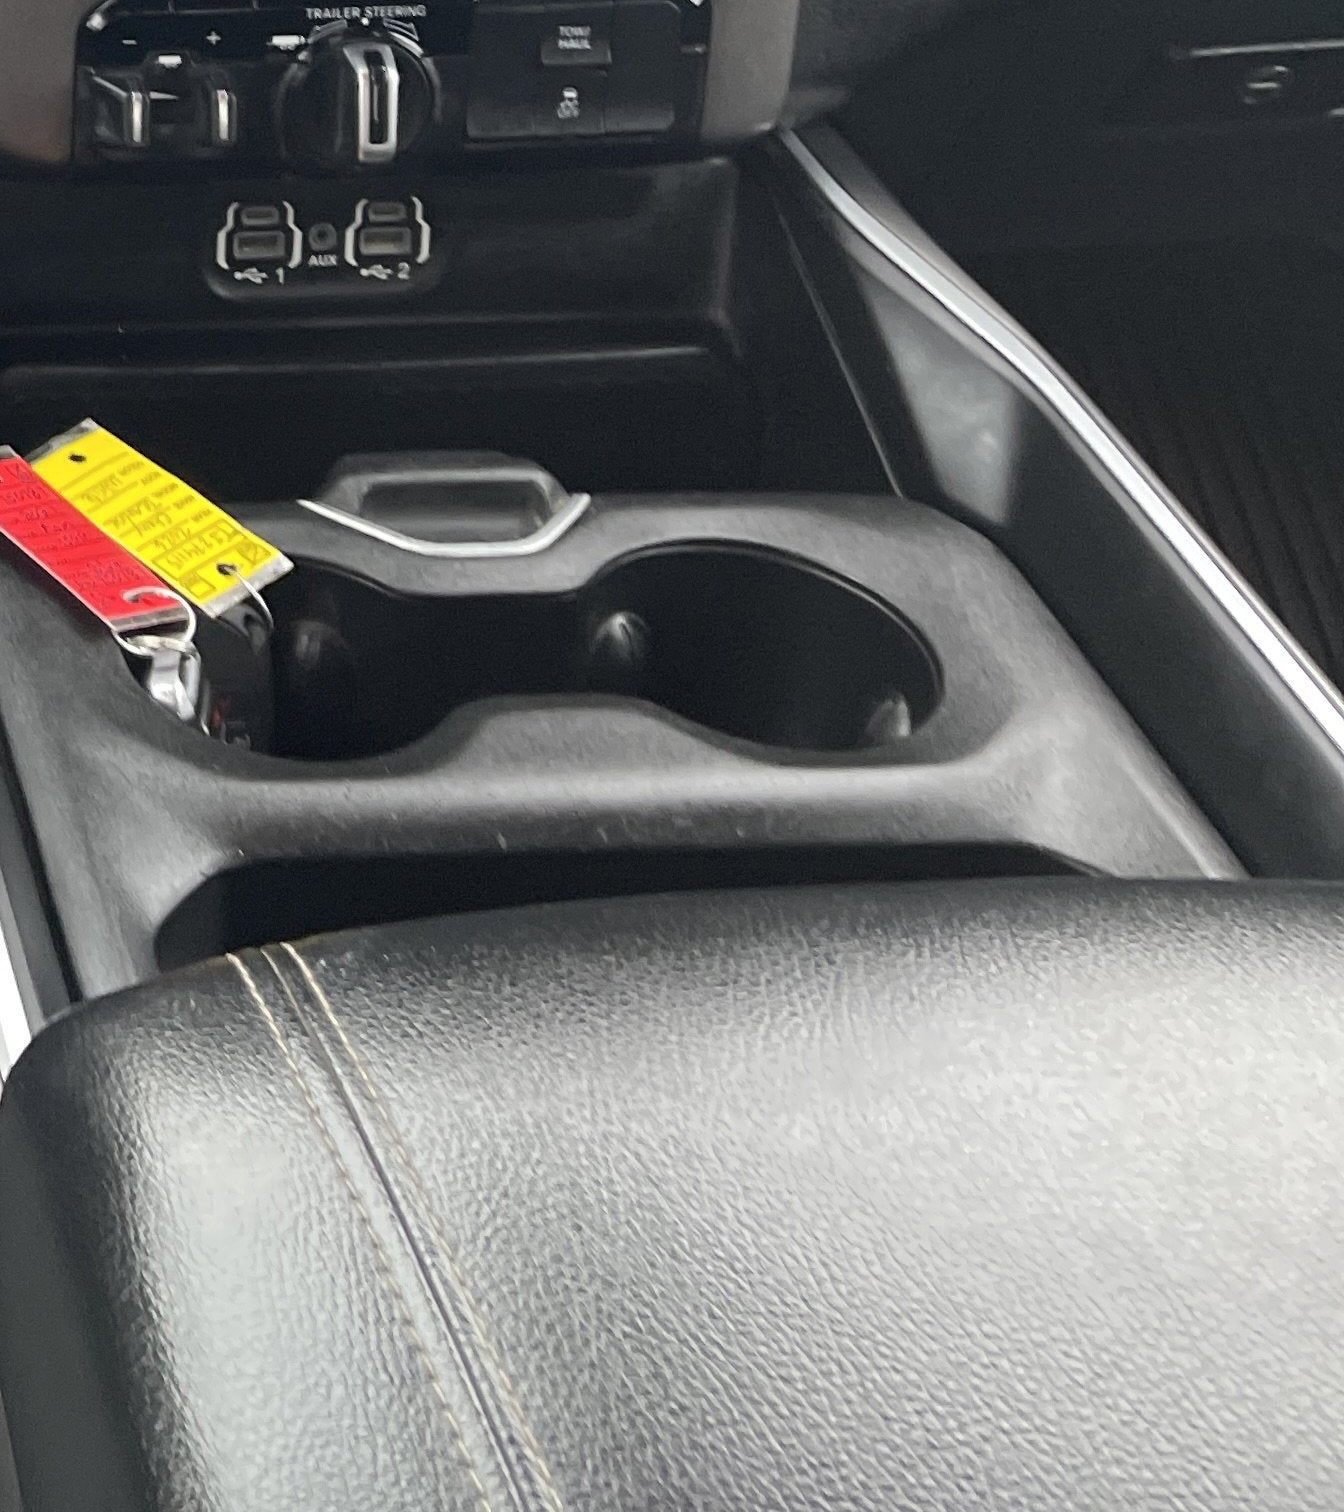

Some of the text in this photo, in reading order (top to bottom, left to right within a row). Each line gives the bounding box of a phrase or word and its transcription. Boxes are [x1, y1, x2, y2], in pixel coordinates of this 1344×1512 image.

[305, 5, 427, 20] TRAILER STEERING
[309, 254, 337, 267] AUX
[276, 267, 284, 284] 1
[397, 262, 410, 280] 2
